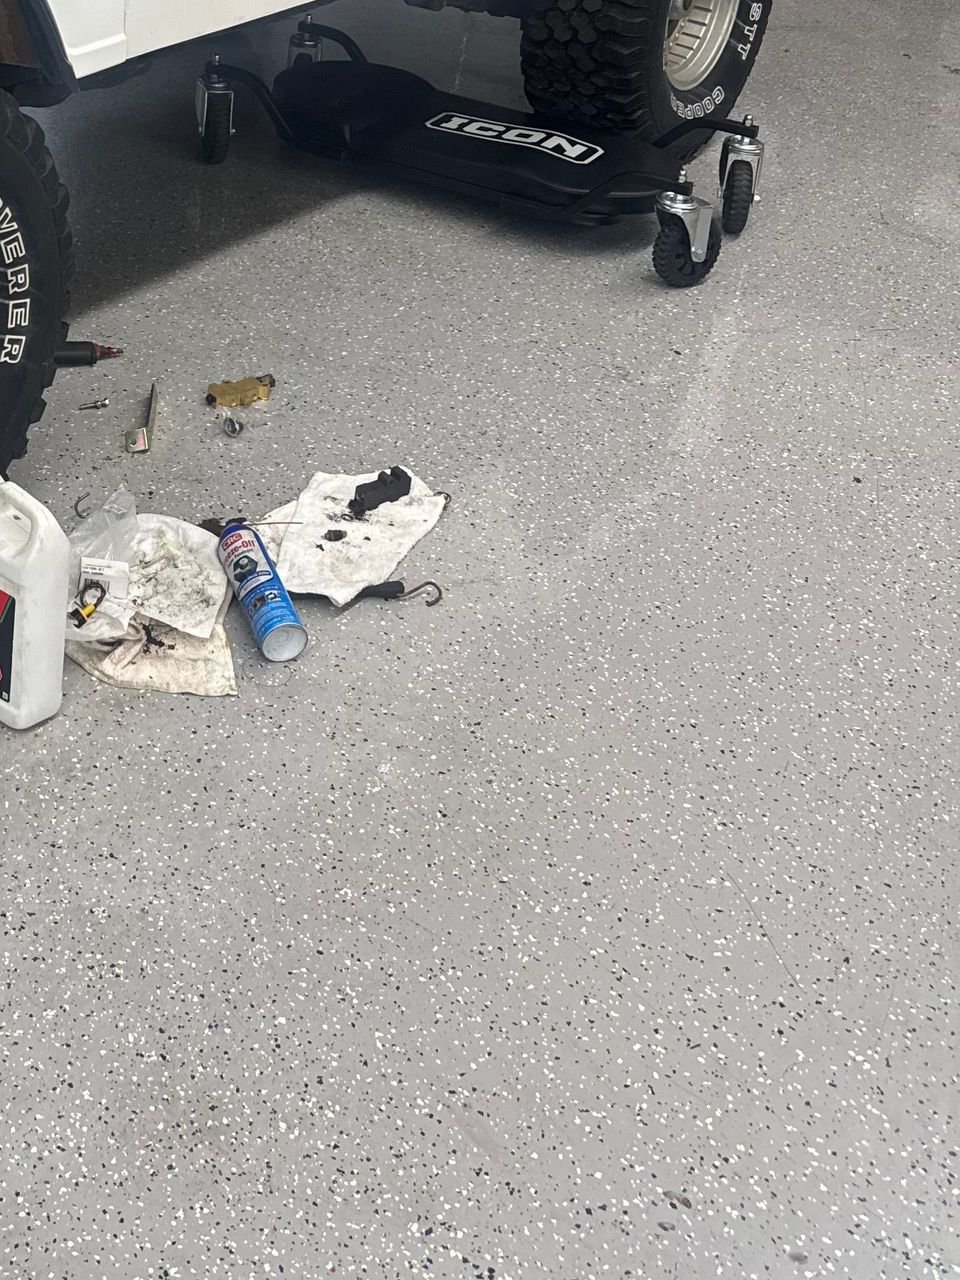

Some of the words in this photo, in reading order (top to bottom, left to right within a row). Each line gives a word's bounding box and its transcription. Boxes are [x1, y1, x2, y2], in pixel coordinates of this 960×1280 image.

[737, 2, 763, 61] STT
[670, 85, 725, 120] COOPER
[440, 116, 589, 158] ICON
[223, 533, 242, 549] CRC
